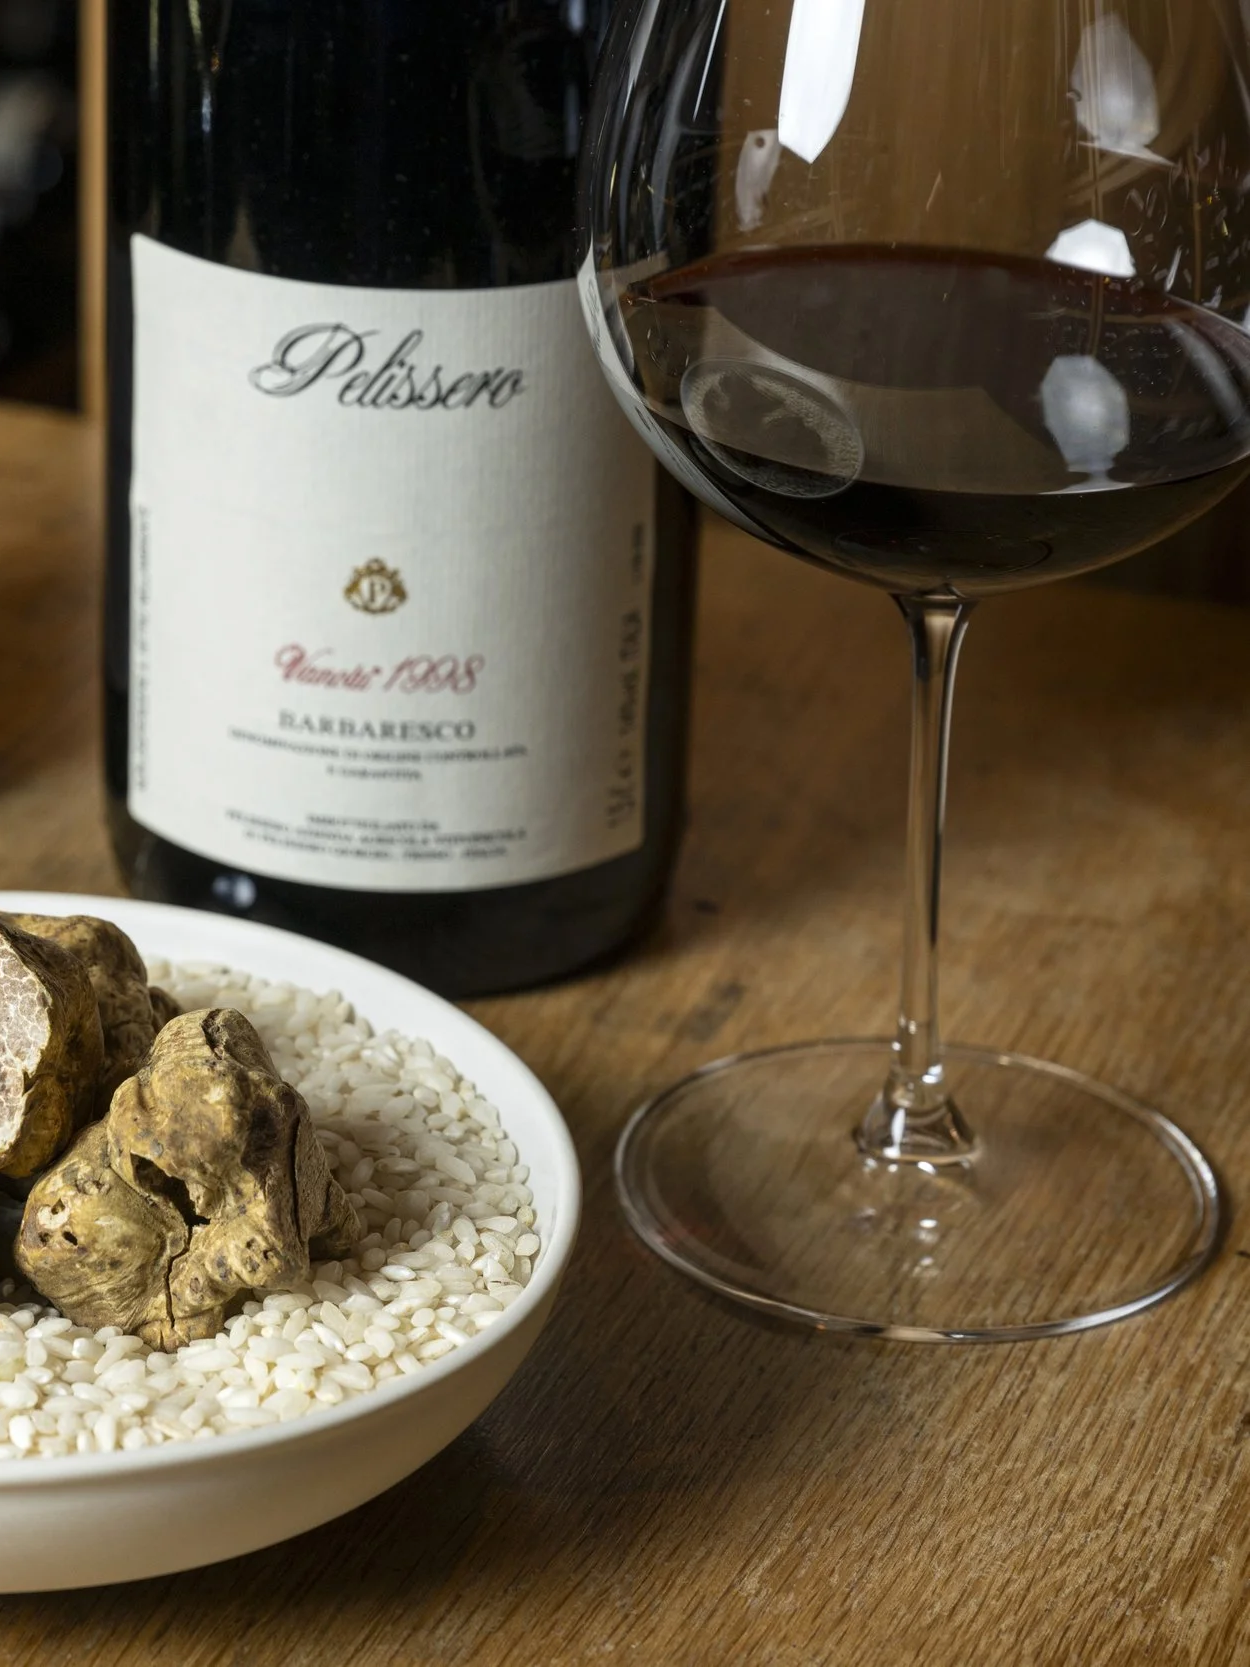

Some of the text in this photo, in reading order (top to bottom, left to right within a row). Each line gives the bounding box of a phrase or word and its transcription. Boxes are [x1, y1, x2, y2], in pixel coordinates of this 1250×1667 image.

[249, 322, 526, 410] Pelissero
[383, 653, 485, 695] 1998
[278, 708, 477, 742] BARBARESCO
